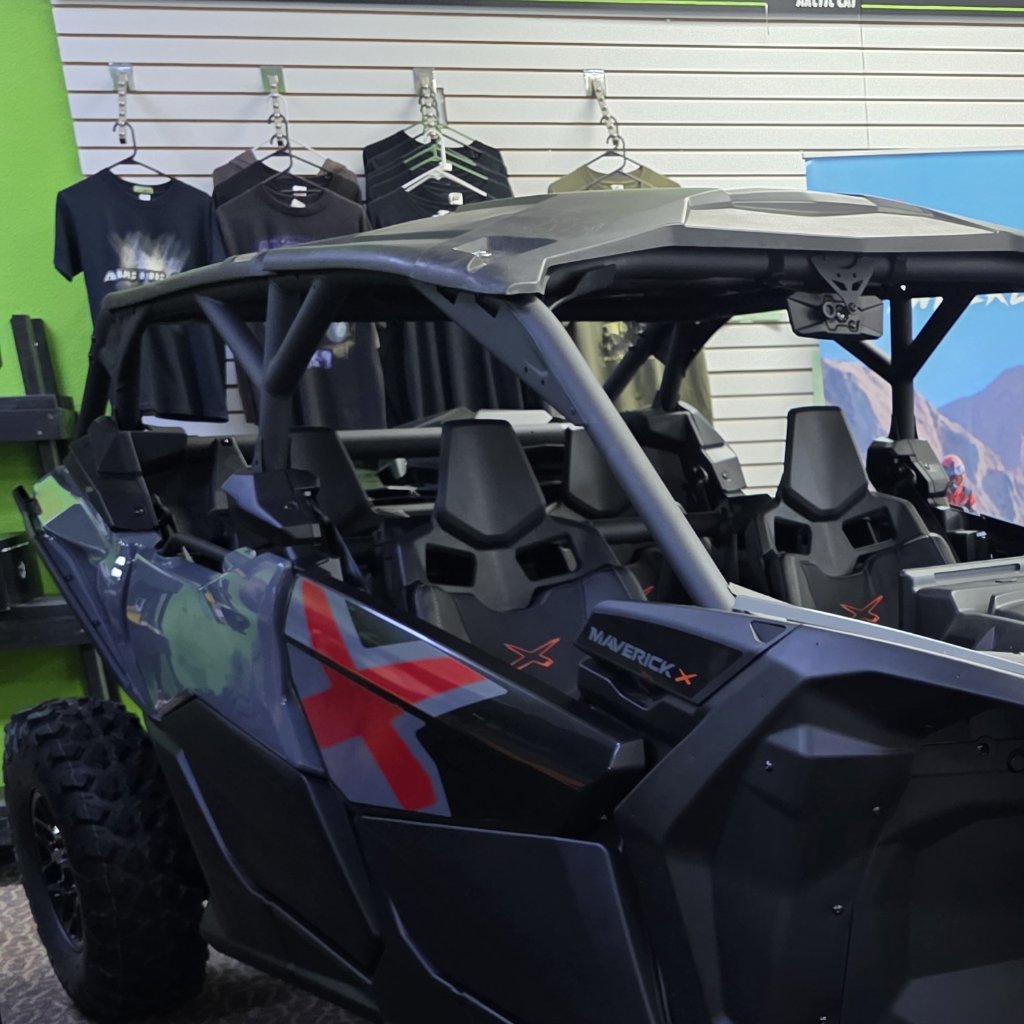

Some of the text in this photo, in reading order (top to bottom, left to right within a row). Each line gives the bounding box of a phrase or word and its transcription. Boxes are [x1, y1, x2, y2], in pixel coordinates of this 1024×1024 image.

[795, 0, 857, 8] ARCTIC CAT
[588, 626, 675, 679] MAVERICK
